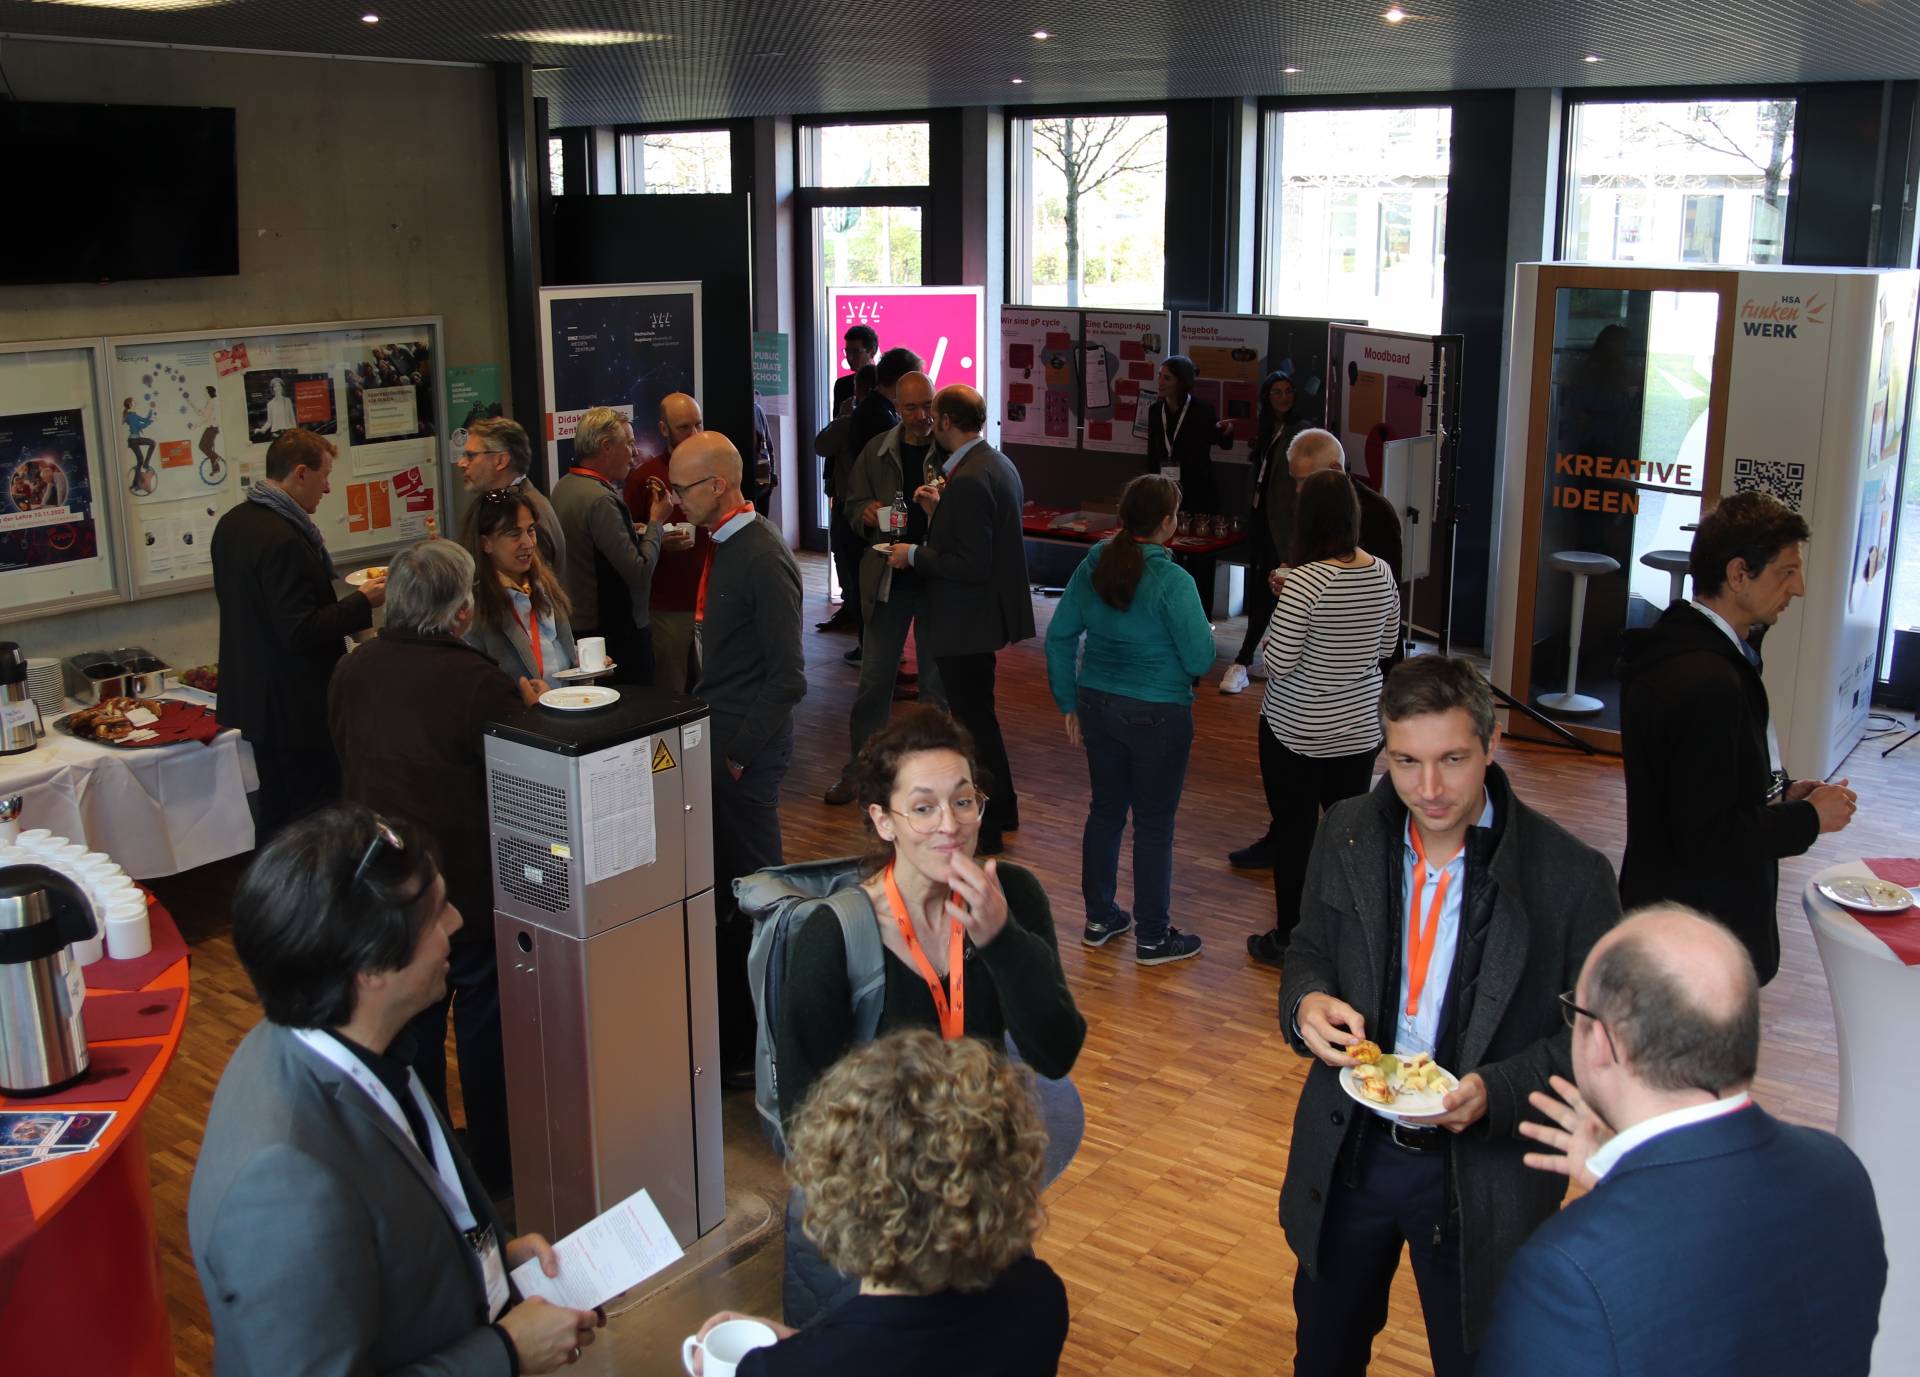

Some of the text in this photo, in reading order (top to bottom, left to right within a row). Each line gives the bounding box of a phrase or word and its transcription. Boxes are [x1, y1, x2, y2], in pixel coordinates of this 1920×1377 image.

[1782, 296, 1800, 304] HSA
[1740, 298, 1800, 322] funken
[1014, 317, 1029, 325] sind
[1042, 318, 1061, 327] cycle
[1086, 320, 1151, 331] Eine Campus-App
[1181, 324, 1219, 334] Angebote
[1744, 322, 1798, 338] WERK
[754, 351, 780, 361] PUBLIC
[1364, 347, 1410, 365] Moodboard
[752, 362, 783, 371] CLIMATE
[753, 372, 782, 382] SCHOOL
[558, 415, 582, 424] Didak
[558, 427, 577, 436] Zent
[1555, 453, 1692, 485] KREATIVE
[1552, 486, 1640, 514] IDEEN
